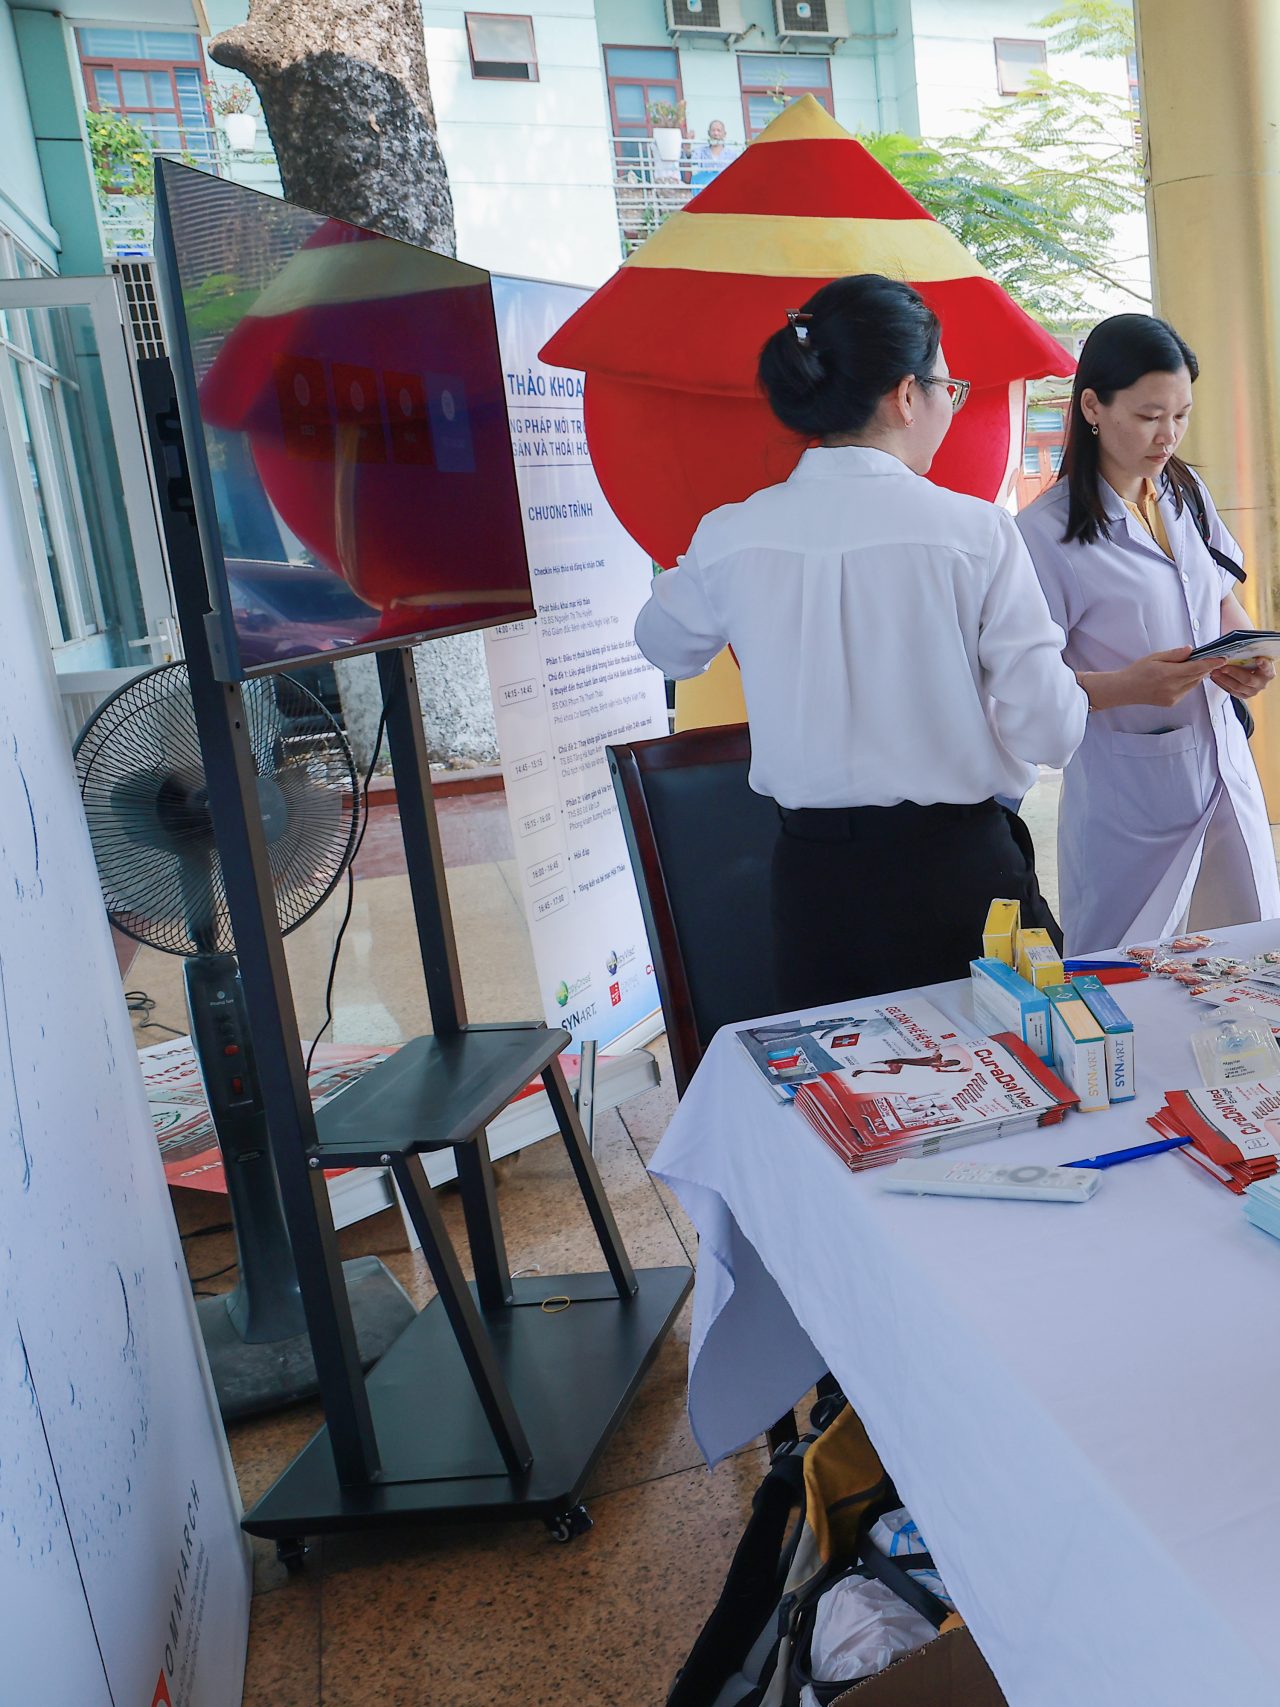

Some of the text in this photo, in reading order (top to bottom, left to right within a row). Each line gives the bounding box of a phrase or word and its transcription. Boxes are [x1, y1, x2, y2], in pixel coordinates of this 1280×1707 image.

[507, 368, 584, 398] THẢO KHOA
[525, 416, 552, 434] PHÁP
[571, 420, 585, 434] TR
[533, 439, 549, 456] VÀ
[549, 439, 575, 456] THOÁI
[528, 499, 593, 521] CHƯƠNG TRÌNH
[974, 1048, 1040, 1109] CuraDol Med
[1088, 1048, 1099, 1097] SYNART
[1114, 1040, 1125, 1088] SYNART
[164, 1479, 200, 1678] OMNIARCH
